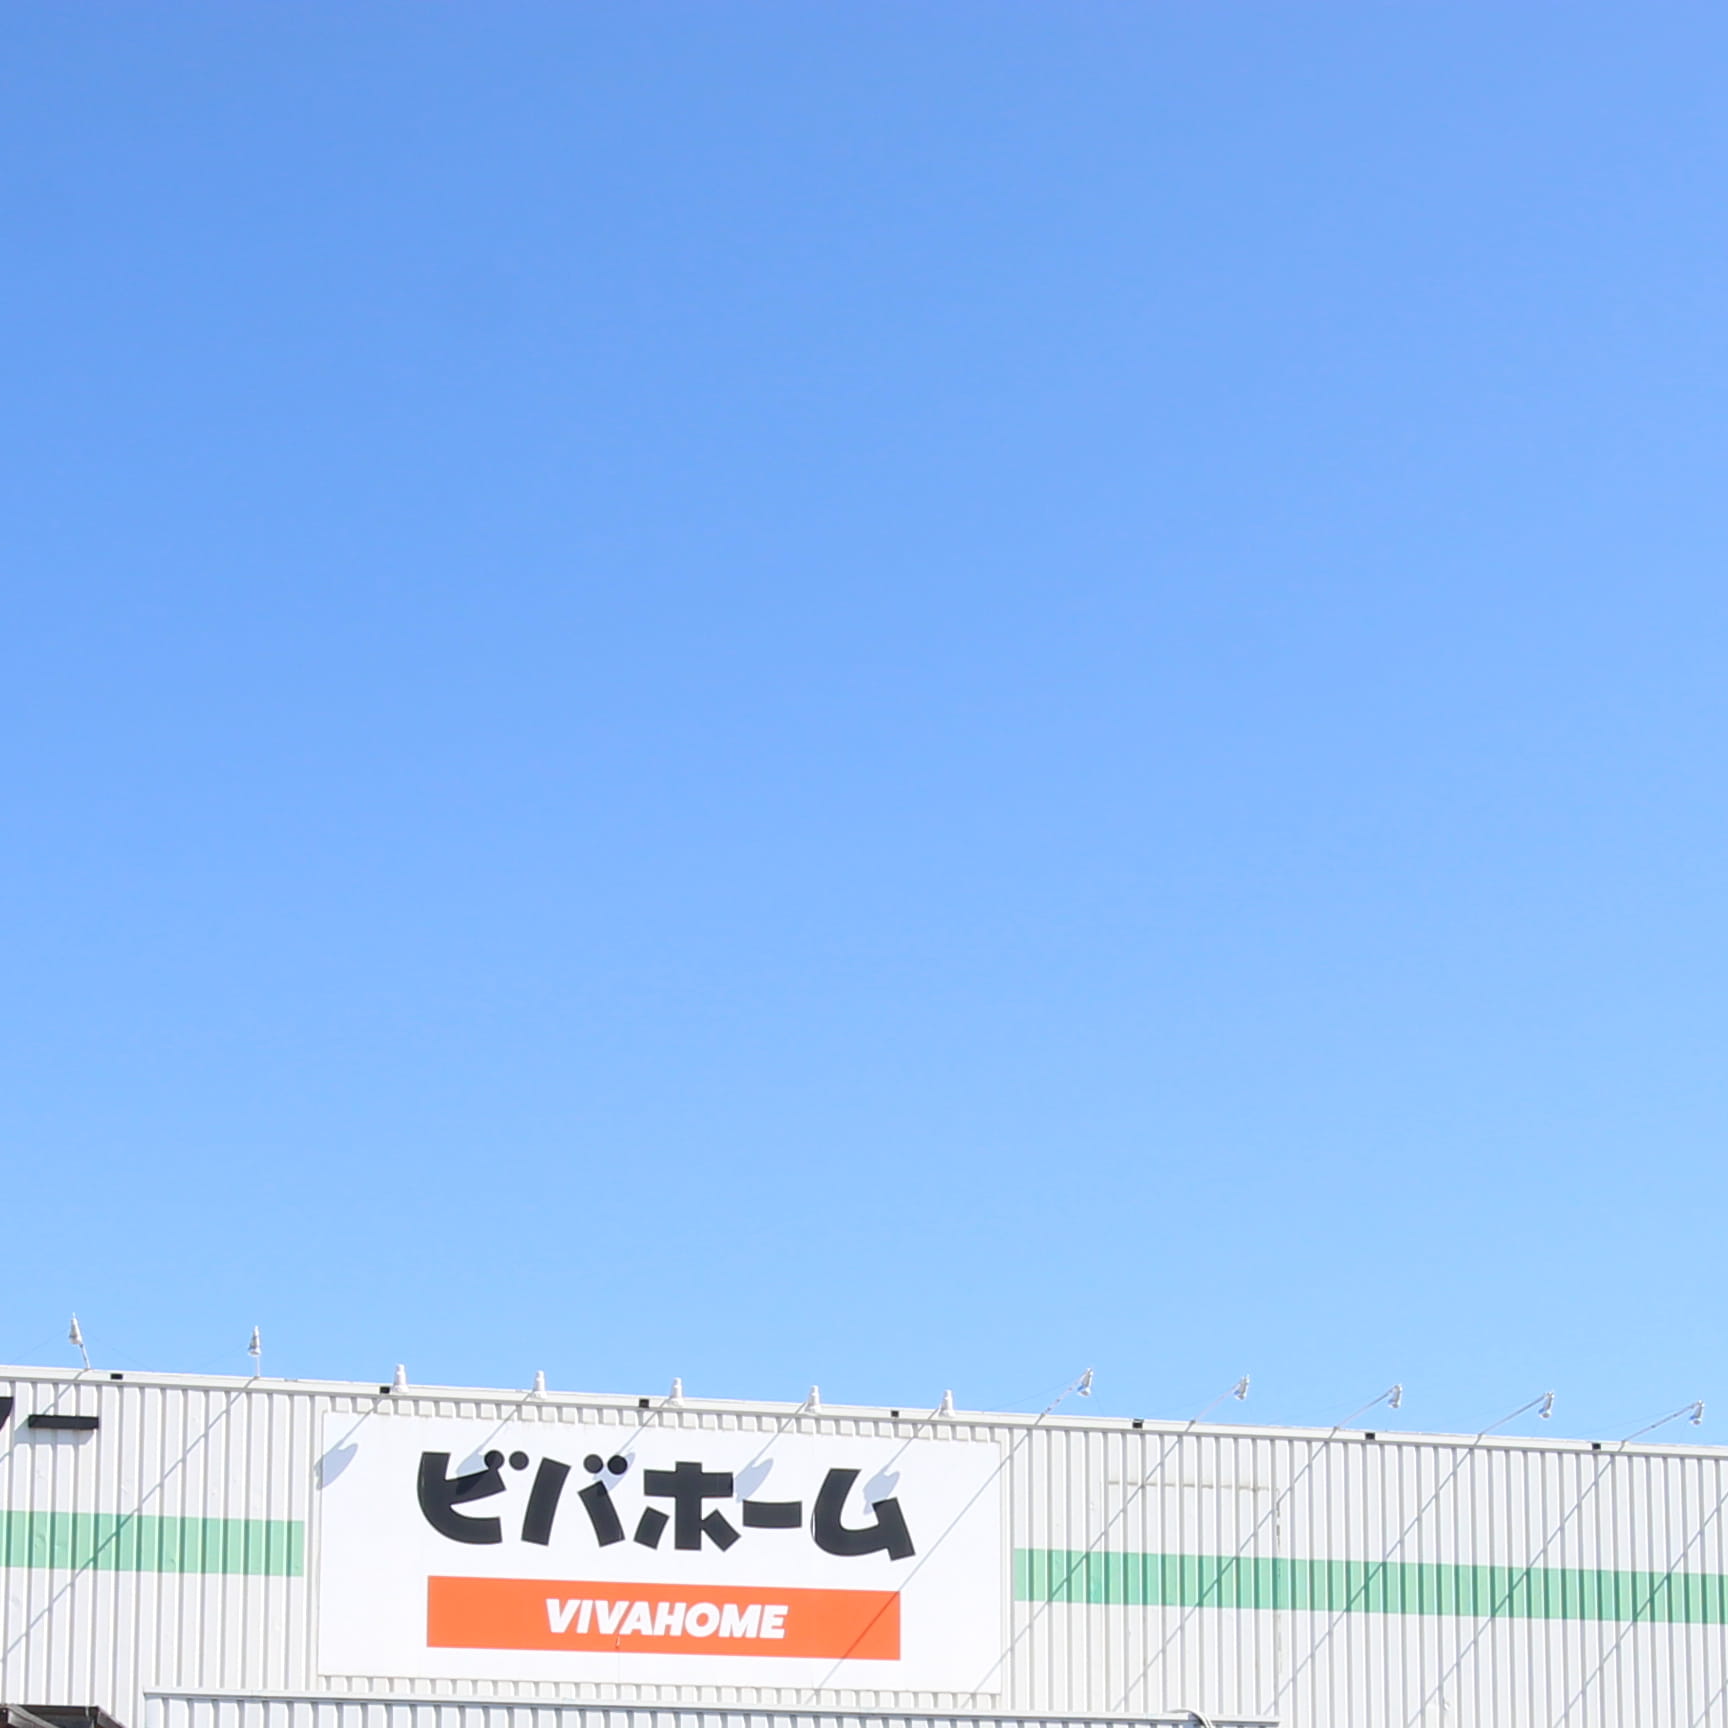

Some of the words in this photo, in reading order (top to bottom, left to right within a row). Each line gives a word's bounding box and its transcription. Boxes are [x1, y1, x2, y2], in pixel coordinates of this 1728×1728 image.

[416, 1450, 916, 1562] ビバホーム
[544, 1598, 788, 1642] VIVAHOME
